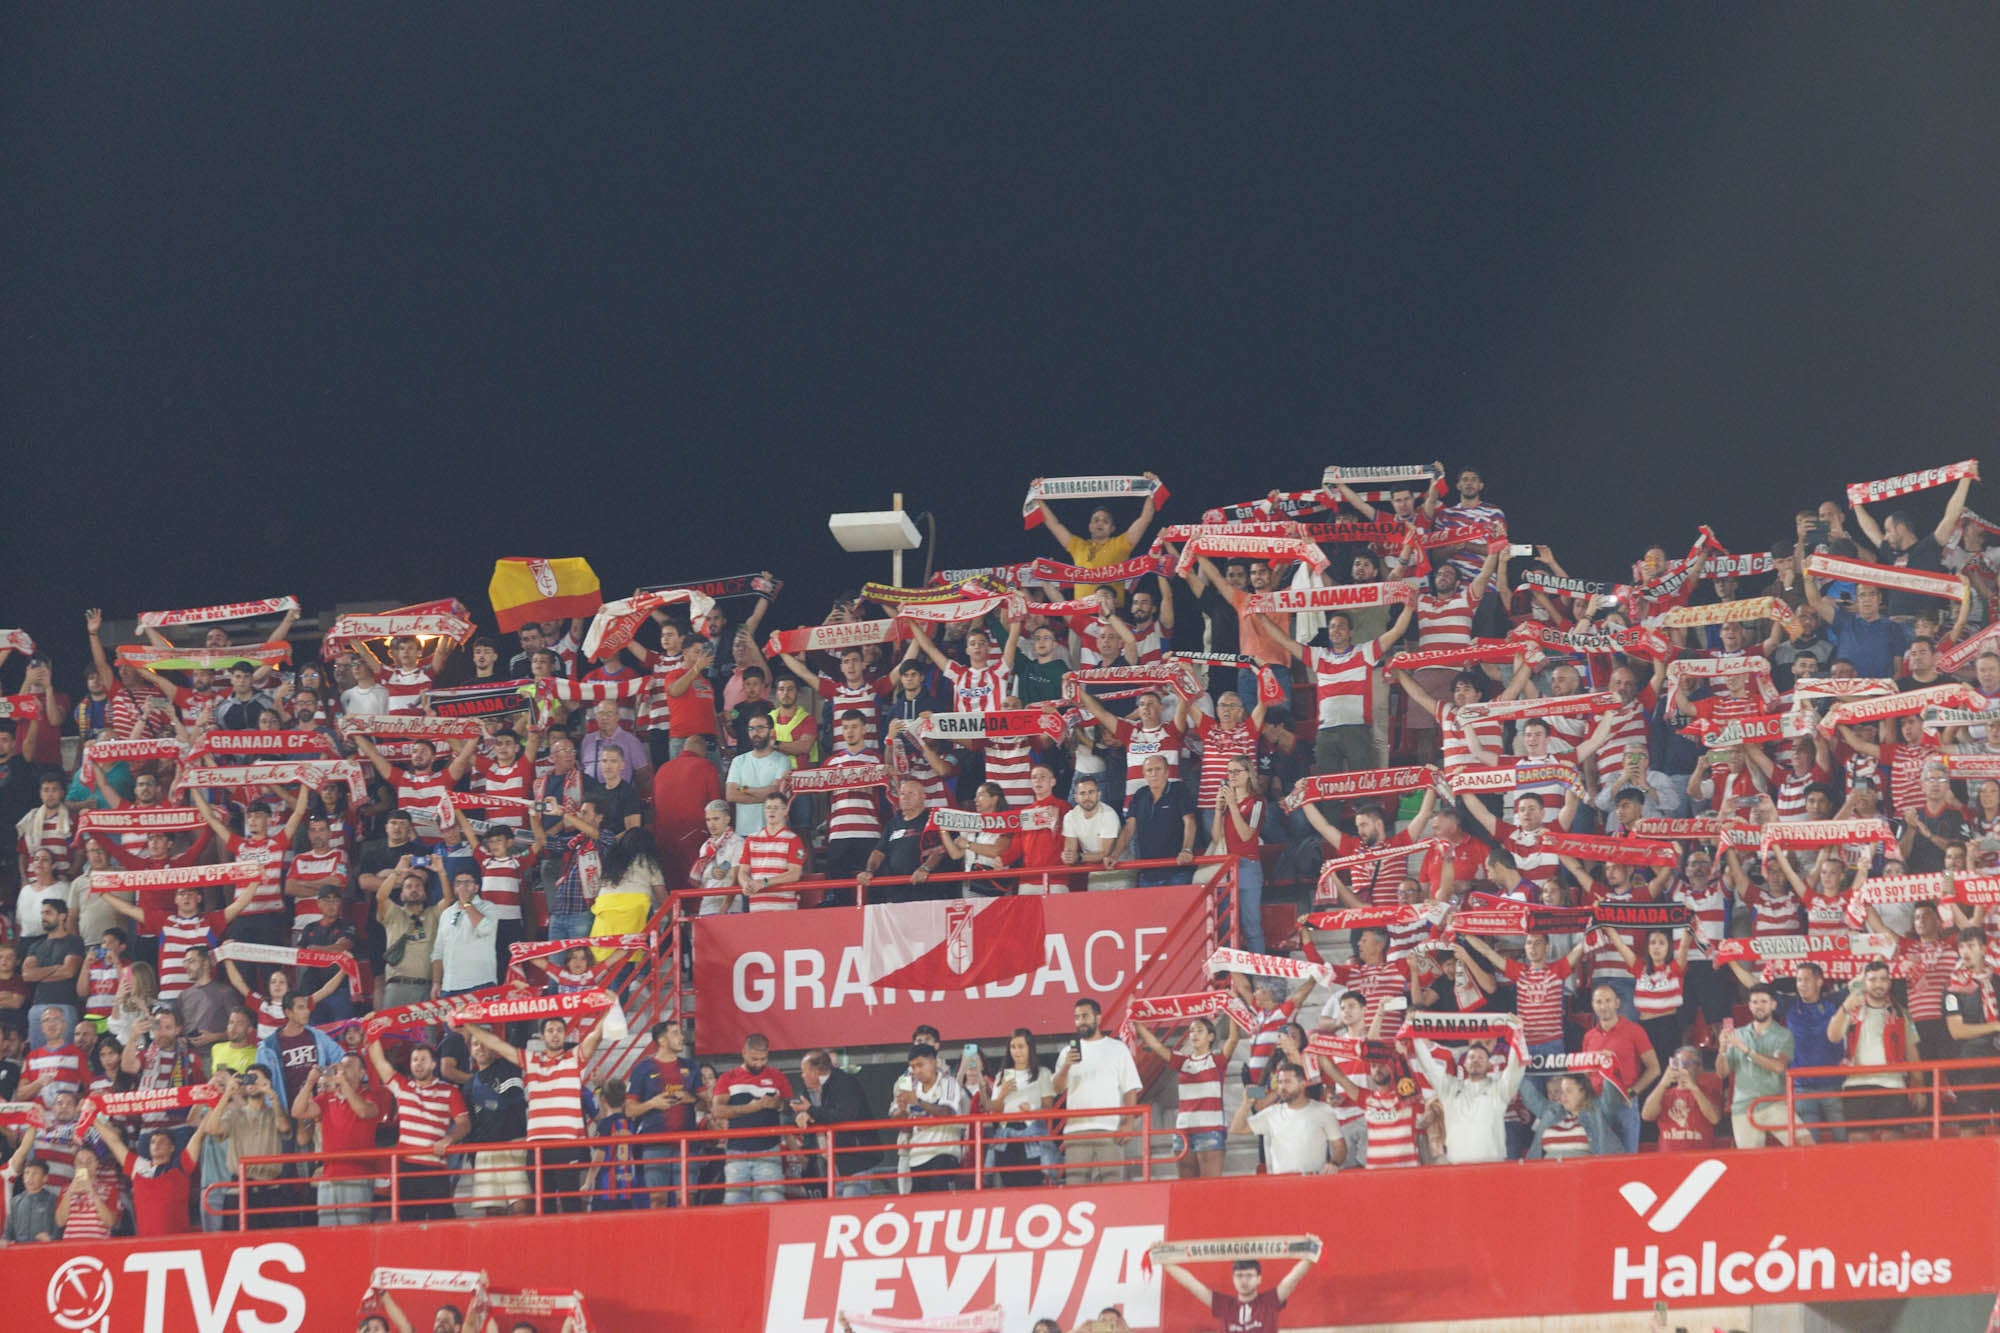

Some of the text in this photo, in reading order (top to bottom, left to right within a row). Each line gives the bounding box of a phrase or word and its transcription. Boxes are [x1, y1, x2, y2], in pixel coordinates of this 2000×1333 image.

[1043, 479, 1126, 495] DERRIBAGIGANTES
[1870, 474, 1926, 495] GRANADA
[1198, 536, 1298, 553] GRANADA CF
[1064, 563, 1124, 579] GRANADA
[1525, 571, 1584, 592] GRANADA
[186, 611, 203, 620] FIN
[207, 609, 224, 620] DEL
[230, 605, 267, 617] MUNDO
[341, 615, 432, 635] Eterna Lucha
[815, 622, 880, 639] GRANADA
[1541, 628, 1612, 647] GRANADA
[1716, 657, 1762, 674] Lucha
[438, 698, 504, 717] GRANADA
[1853, 694, 1927, 718] GRANADA
[1932, 688, 1957, 704] CF
[939, 715, 1008, 732] GRANADA
[211, 735, 308, 749] GRANADA CF
[197, 767, 287, 784] Eterna Lucha
[1361, 772, 1380, 790] Club
[1382, 772, 1391, 785] de
[1452, 773, 1512, 787] GRANADA
[1517, 769, 1576, 784] BARCELONA
[933, 814, 1005, 831] GRANADA
[1774, 821, 1878, 842] GRANADA CF
[124, 866, 226, 885] GRANADA CF
[1866, 886, 1882, 900] YO
[1885, 885, 1907, 898] SOY
[1909, 883, 1928, 896] DEL
[1594, 907, 1668, 923] GRANADA
[1750, 935, 1833, 954] GRANADA
[489, 995, 580, 1017] GRANADA CF
[1412, 1017, 1490, 1033] GRANADA
[103, 1086, 178, 1103] GRANADA
[106, 1102, 129, 1115] CLUB
[131, 1100, 143, 1112] DE
[824, 1203, 1096, 1258] RÓTULOS
[1191, 1242, 1283, 1257] DERRIBAGIGANTES
[1613, 1235, 1952, 1300] Halcón viajes
[763, 1225, 1165, 1333] LEYVA
[123, 1243, 306, 1333] TVS
